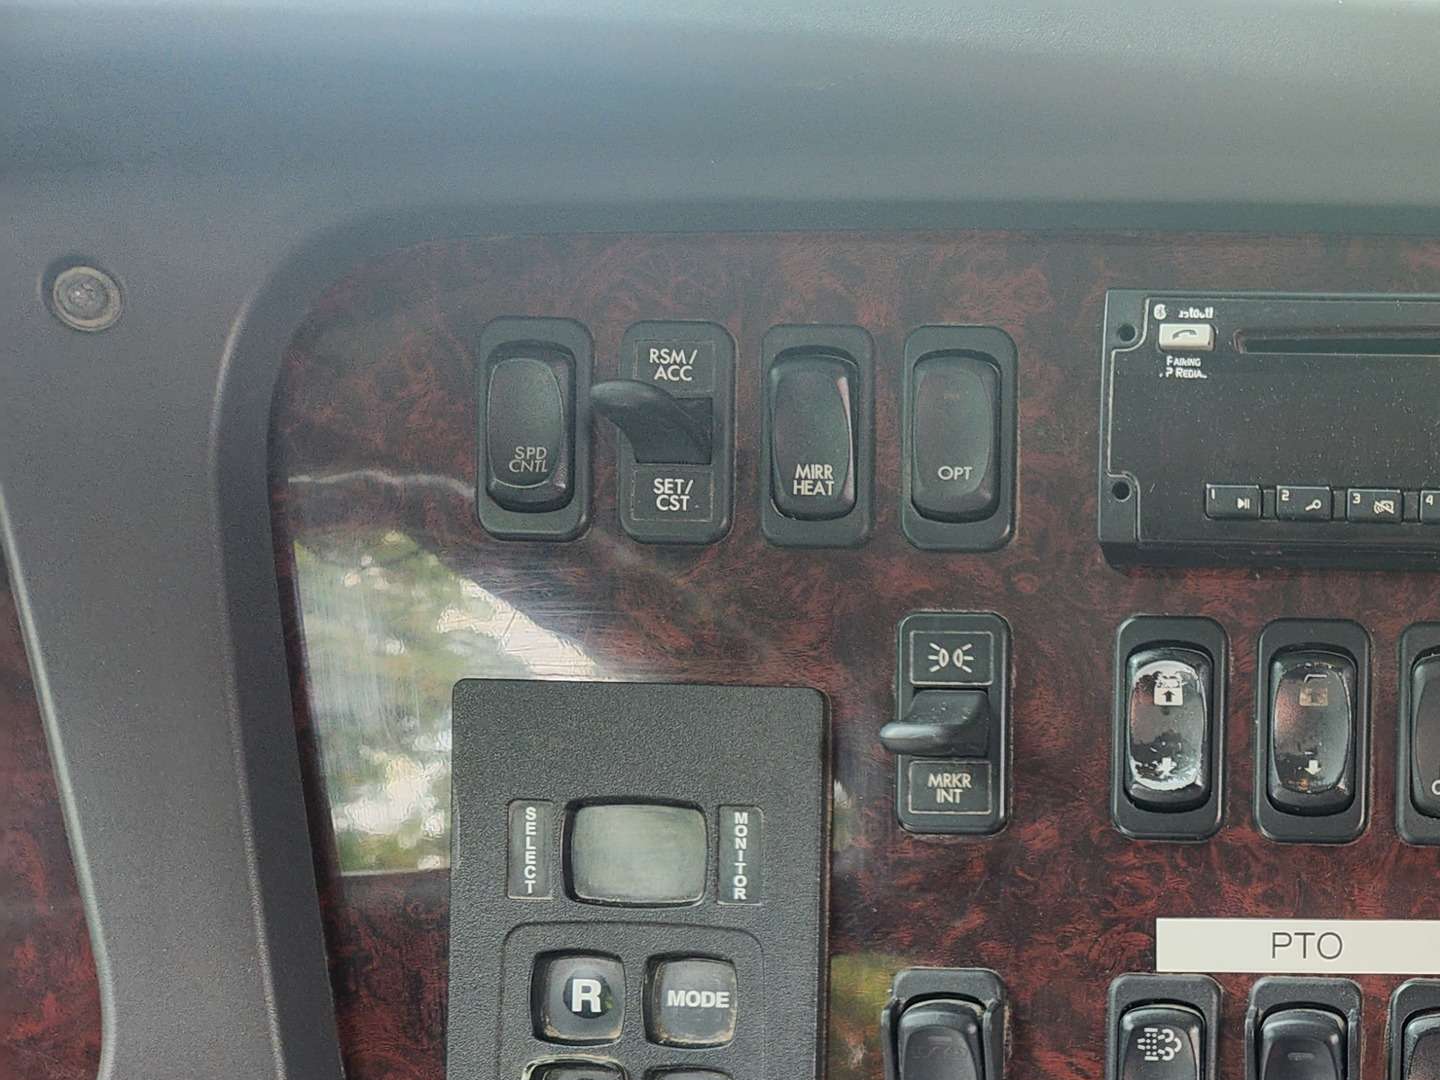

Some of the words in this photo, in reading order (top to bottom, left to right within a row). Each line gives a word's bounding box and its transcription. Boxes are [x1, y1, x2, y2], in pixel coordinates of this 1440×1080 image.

[649, 348, 697, 364] RSM/
[654, 364, 693, 382] ACC
[514, 446, 547, 461] SPD
[508, 459, 548, 474] CNTL
[795, 464, 834, 480] MIRR
[937, 465, 973, 481] OPT
[653, 477, 694, 496] SET/
[793, 479, 835, 496] HEAT
[1210, 489, 1216, 500] 1
[1281, 489, 1290, 501] 2
[1352, 492, 1361, 504] 3
[1425, 494, 1434, 506] 4
[656, 495, 690, 512] CST
[928, 773, 972, 788] MRKR
[936, 788, 963, 804] INT
[523, 806, 537, 895] SELECT
[733, 811, 748, 900] MONITOR
[1272, 932, 1343, 960] PTO
[571, 979, 602, 1013] R
[667, 990, 730, 1008] MODE
